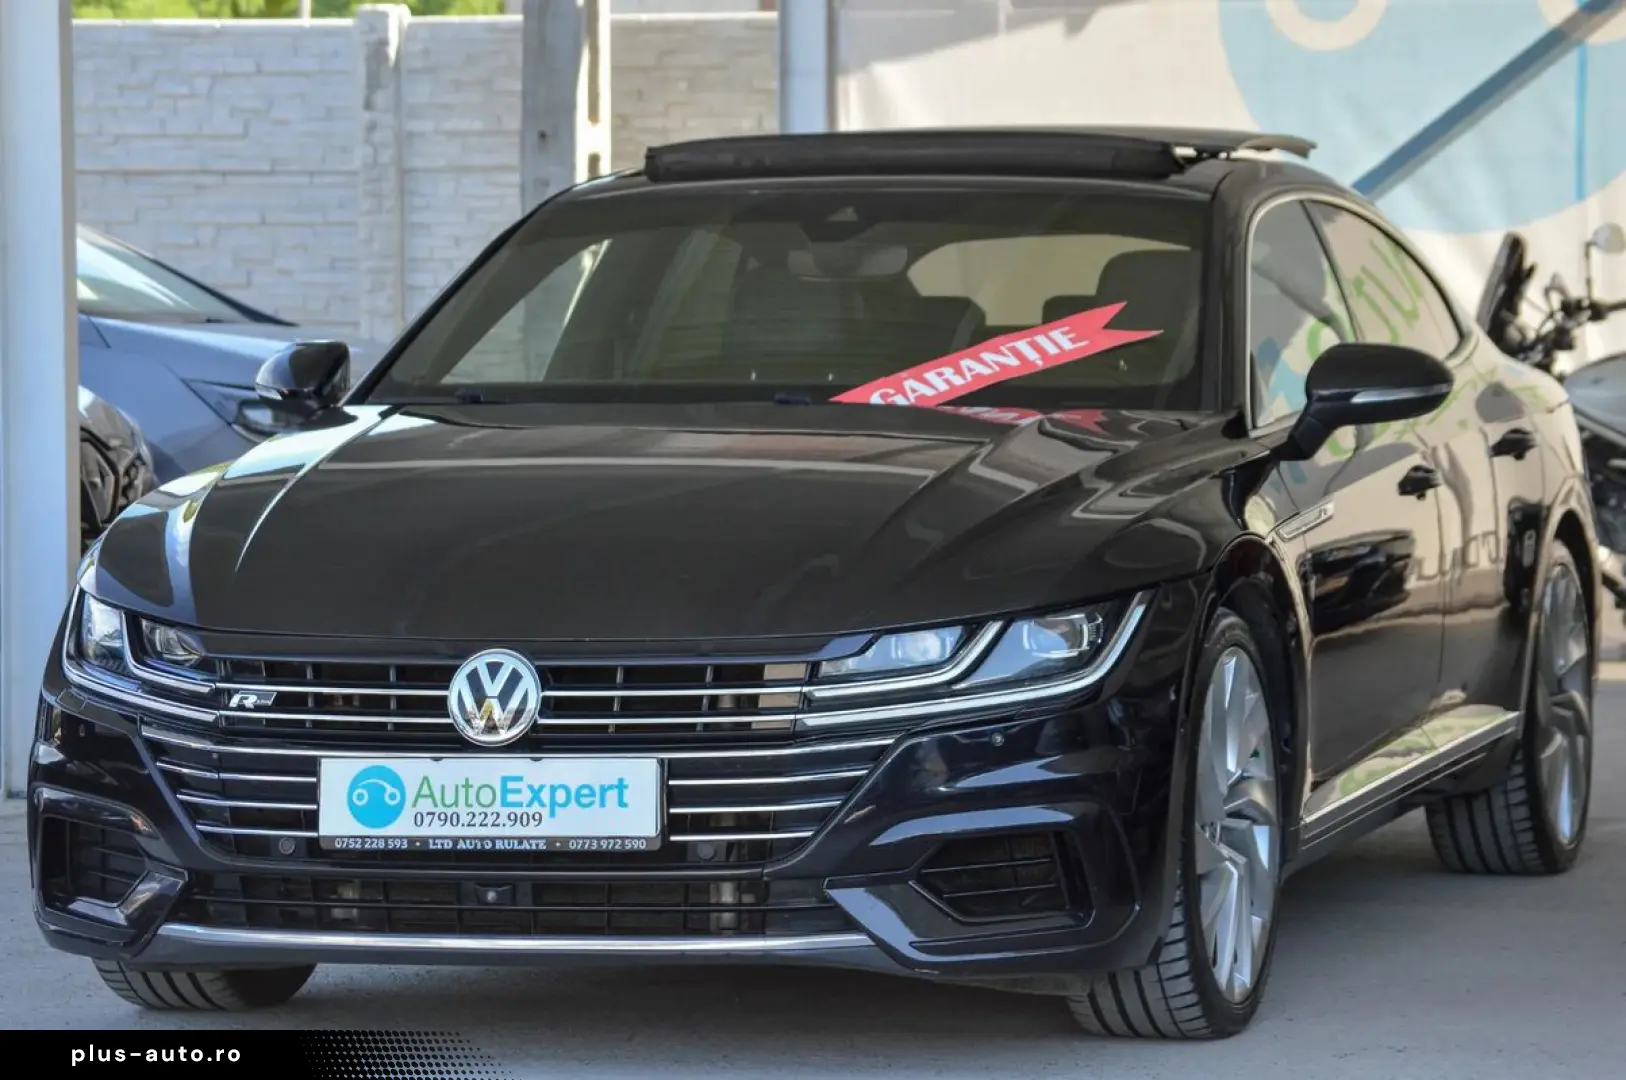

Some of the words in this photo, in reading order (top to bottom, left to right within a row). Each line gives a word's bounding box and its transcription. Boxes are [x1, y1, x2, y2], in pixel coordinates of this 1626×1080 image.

[411, 775, 629, 819] AutoExpert
[413, 811, 543, 828] 0790.222.909
[334, 837, 362, 849] 0752
[364, 838, 385, 849] 228
[387, 838, 408, 849] 593
[456, 838, 493, 850] AUTO
[495, 838, 547, 850] RULATE
[568, 838, 597, 850] 0773
[600, 838, 622, 850] 972
[624, 838, 647, 850] 590
